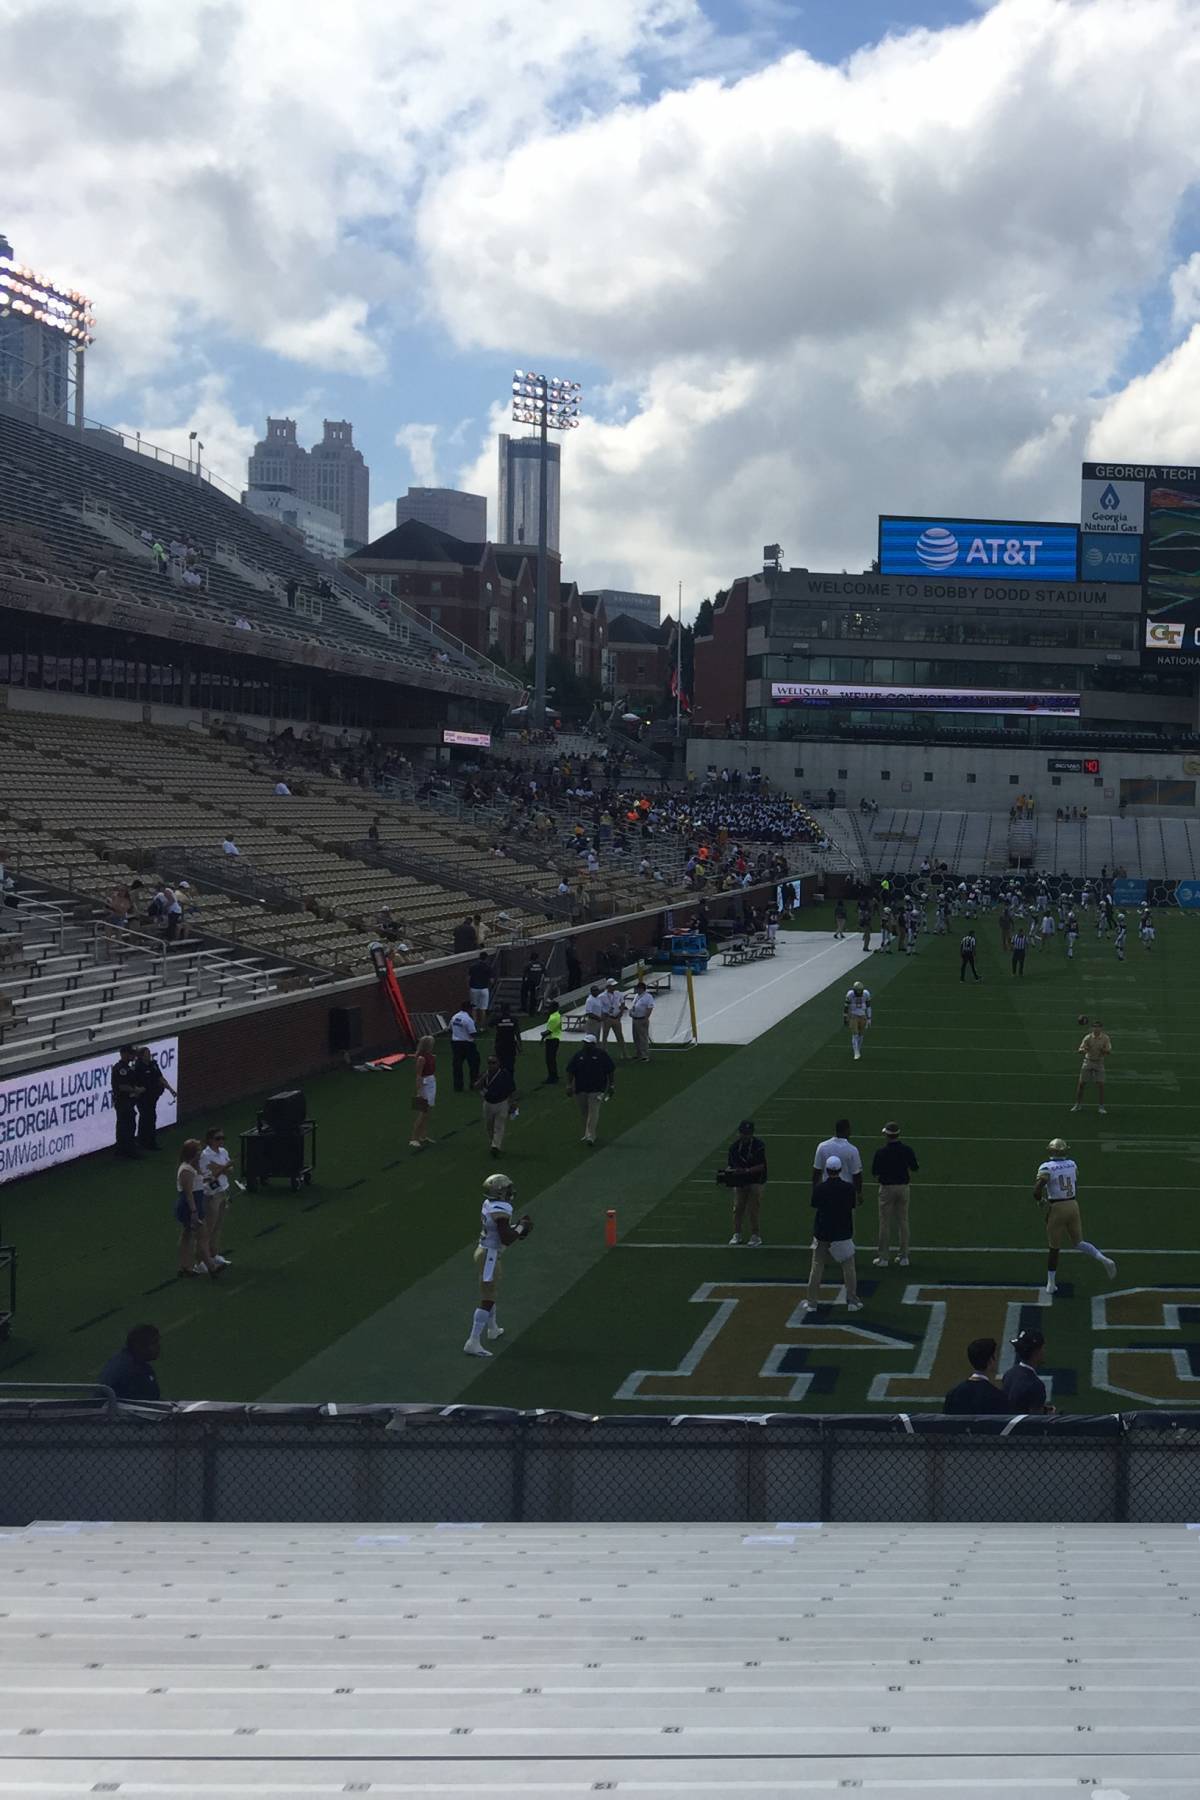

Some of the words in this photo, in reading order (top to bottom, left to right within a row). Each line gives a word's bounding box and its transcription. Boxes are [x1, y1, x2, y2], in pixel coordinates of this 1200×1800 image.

[1096, 466, 1157, 479] GEORGIA
[1161, 468, 1196, 480] TECH
[1084, 522, 1118, 531] Natural
[1121, 523, 1137, 532] Gas
[1092, 512, 1128, 523] Georgia
[966, 539, 1043, 566] AT&T
[1105, 553, 1137, 565] AT&T
[808, 581, 890, 596] WELCOME
[896, 584, 918, 597] TO
[924, 586, 978, 600] BOBBY
[984, 587, 1030, 601] DODD
[1036, 589, 1107, 604] STADIUM
[0, 1081, 59, 1116] OFFICIAL
[61, 1067, 110, 1099] LUXURY
[161, 1048, 175, 1069] OF
[0, 1107, 59, 1141] GEORGIA
[1058, 1174, 1074, 1197] 4
